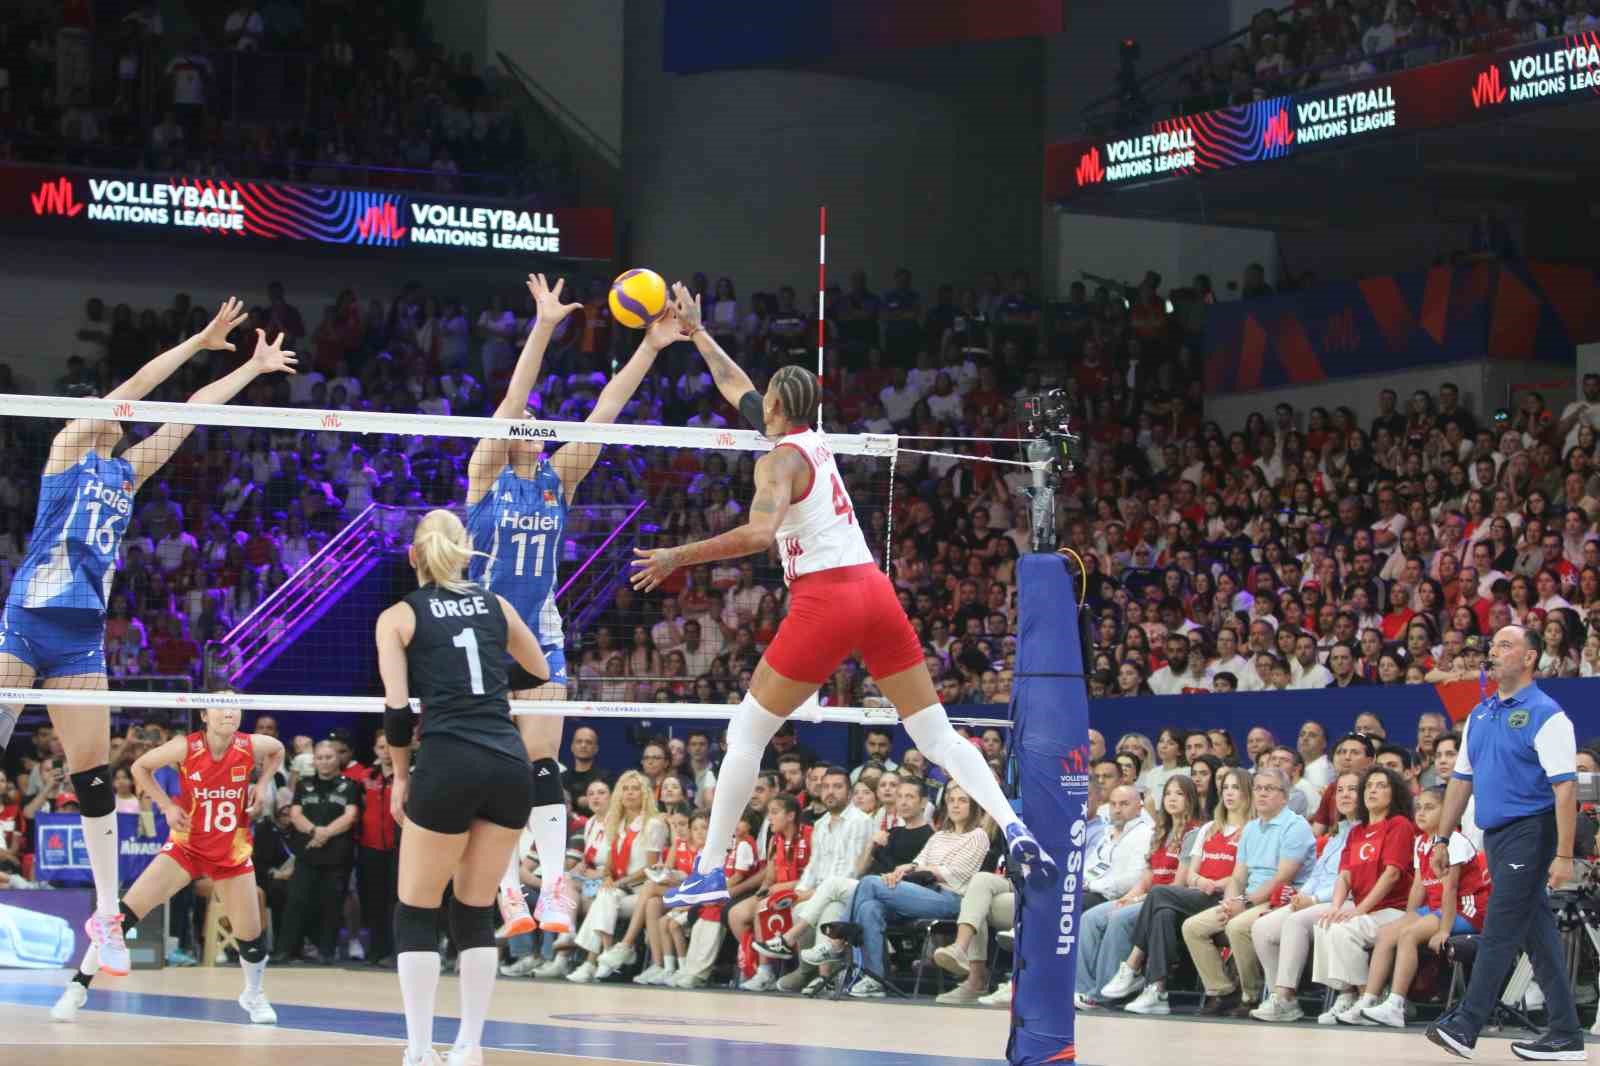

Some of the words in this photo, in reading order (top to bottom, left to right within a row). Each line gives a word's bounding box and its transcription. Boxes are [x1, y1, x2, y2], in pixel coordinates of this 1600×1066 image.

[1509, 43, 1600, 81] VOLLEYBA
[1297, 86, 1396, 124] VOLLEYBALL
[1509, 75, 1566, 102] NATIONS
[1296, 119, 1347, 144] NATIONS
[1350, 110, 1396, 134] LEAGUE
[1106, 127, 1196, 162] VOLLEYBALL
[1105, 158, 1152, 182] NATIONS
[1153, 150, 1196, 173] LEAGUE
[88, 178, 244, 210] VOLLEYBALL
[87, 203, 169, 224] NATIONS
[173, 209, 244, 230] LEAGUE
[411, 203, 560, 234] VOLLEYBALL
[410, 227, 488, 248] NATIONS
[492, 232, 560, 253] LEAGUE
[830, 473, 853, 525] 4
[85, 502, 123, 554] 16
[511, 532, 546, 577] 11
[429, 596, 489, 618] ÖRGE
[452, 627, 485, 695] 1
[193, 786, 243, 800] Haier
[200, 800, 237, 833] 18
